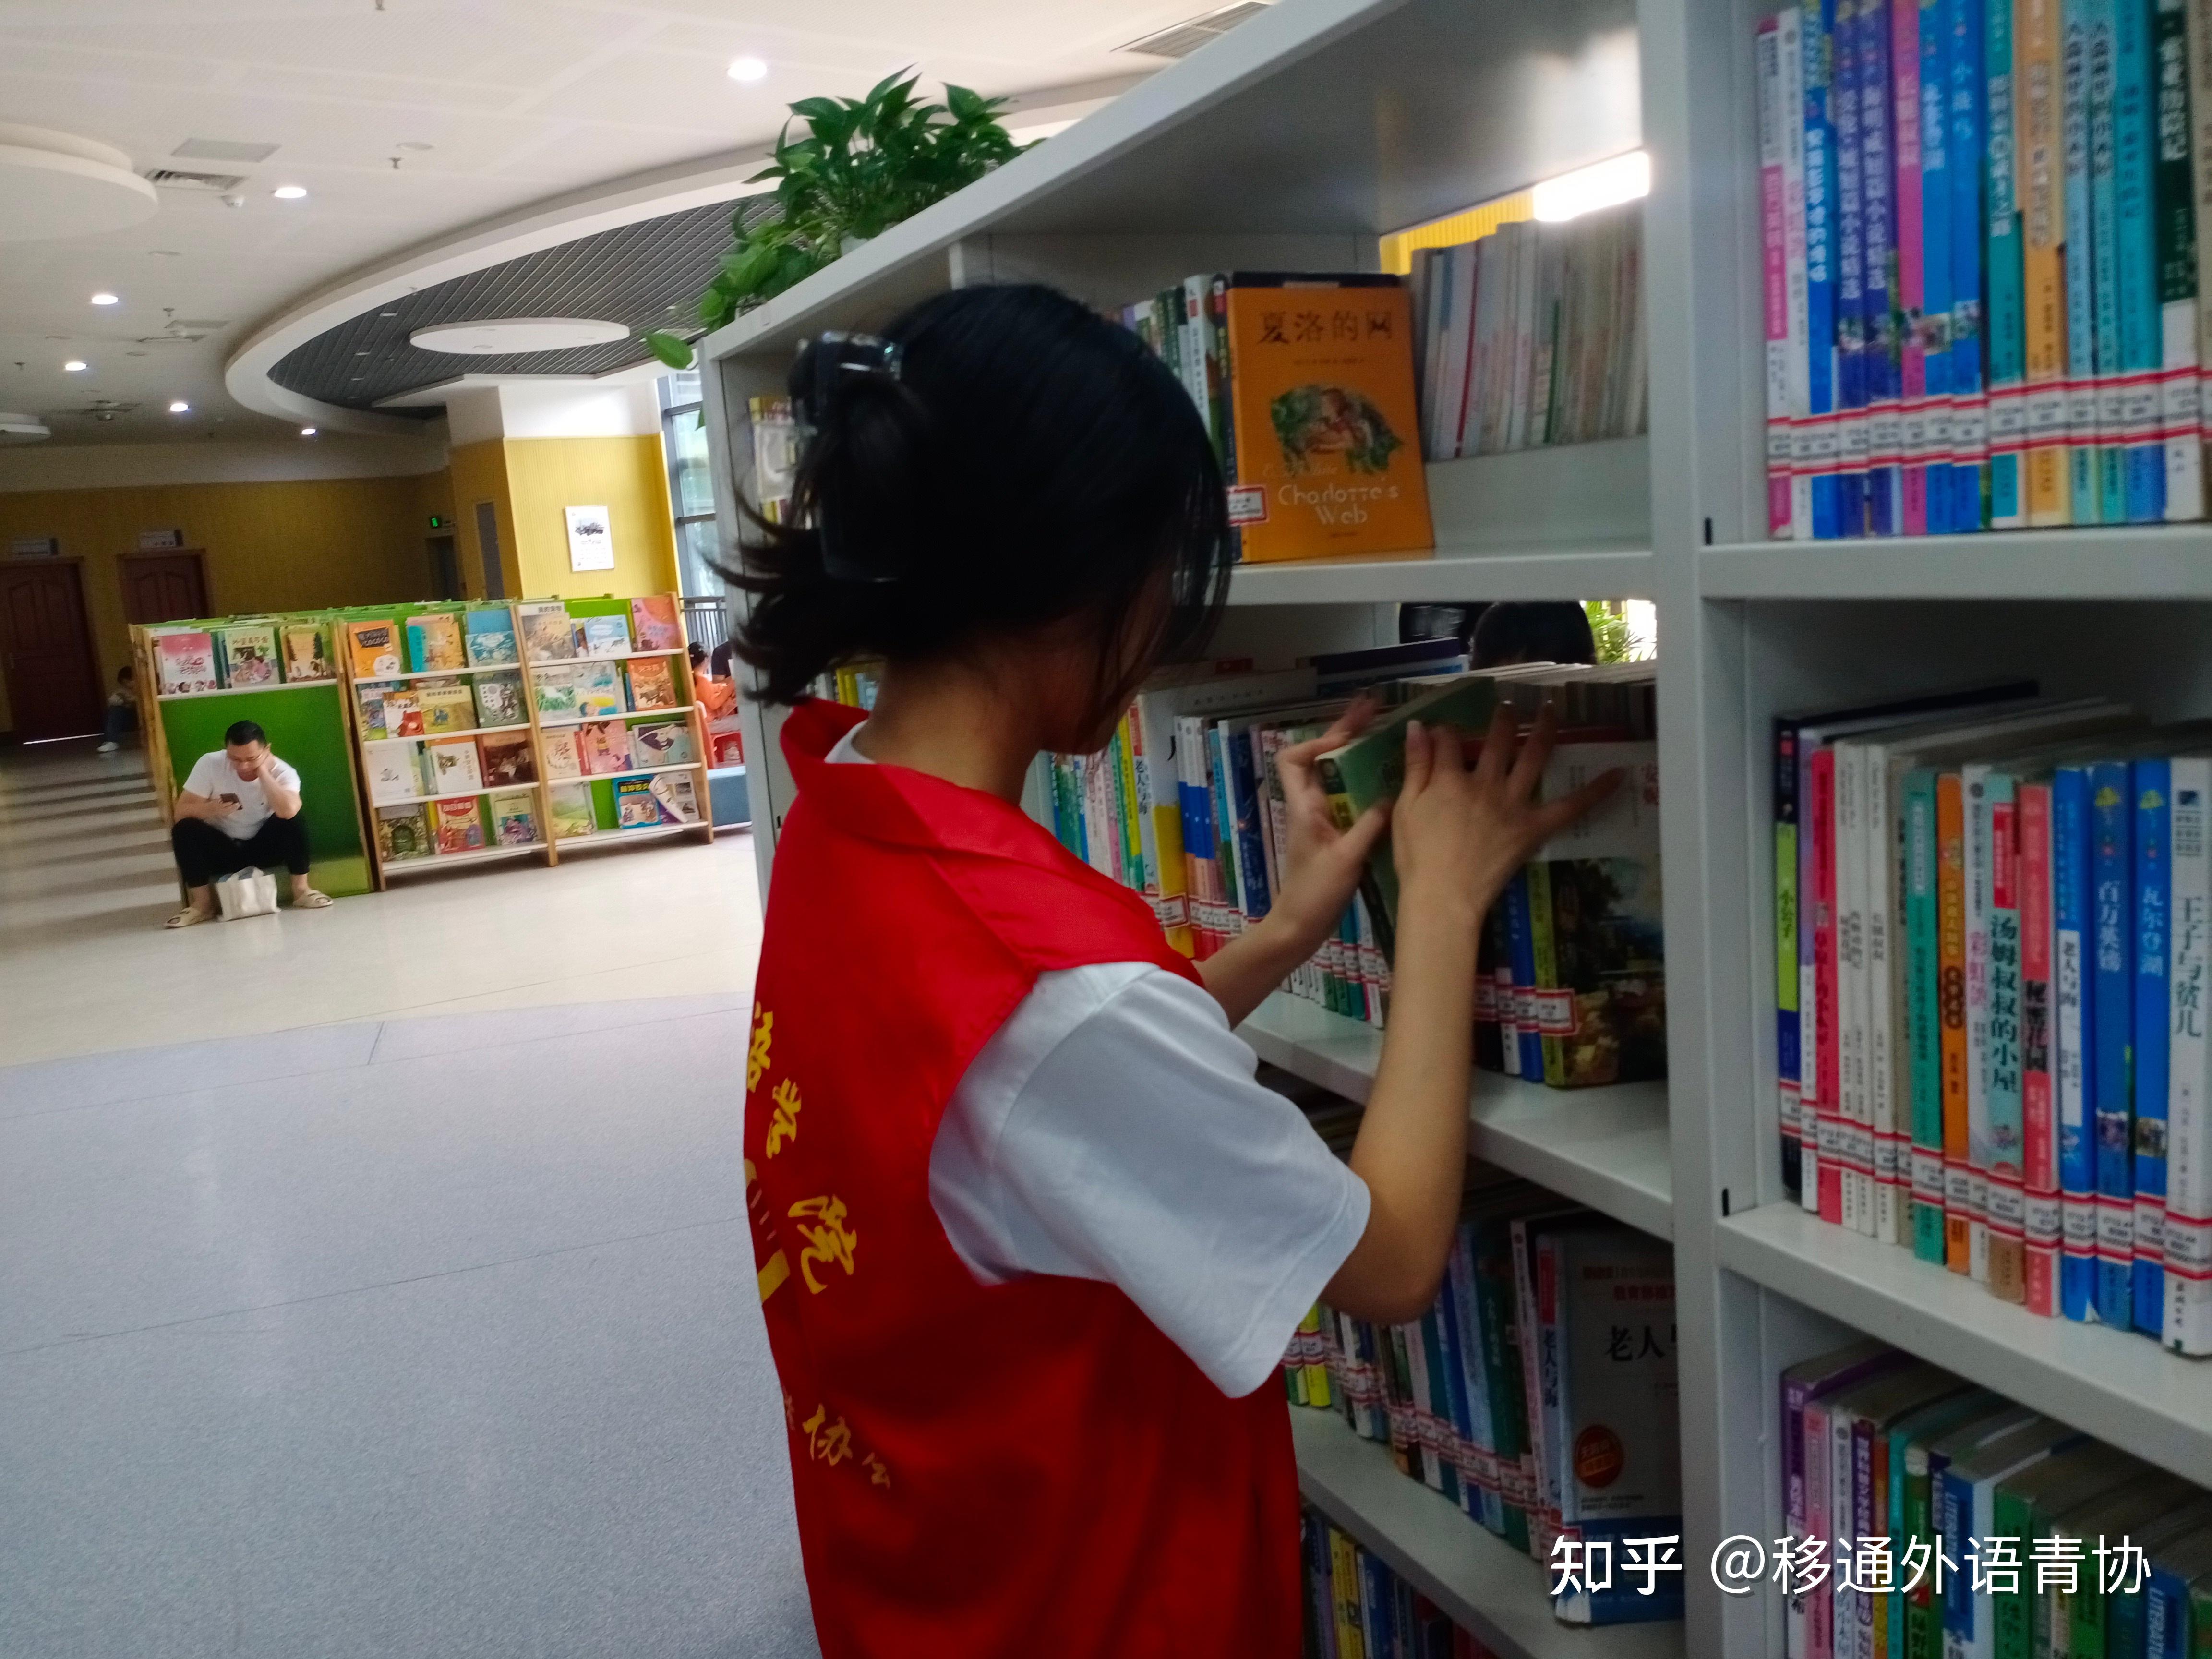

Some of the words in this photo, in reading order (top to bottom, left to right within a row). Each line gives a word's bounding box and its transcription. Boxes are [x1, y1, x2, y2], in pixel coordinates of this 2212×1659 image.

[1257, 310, 1392, 344] 夏洛的网
[1278, 477, 1399, 506] Charlotte's
[1315, 505, 1368, 525] Web
[1135, 759, 1149, 817] 老人与海
[2098, 880, 2122, 973] 百万英镑
[2140, 886, 2164, 976] 瓦尔登湖
[1991, 914, 2018, 1092] 汤姆叔叔的小屋
[2061, 941, 2078, 1008] 老人与海
[2174, 896, 2202, 1038] 王子与贫儿
[2024, 980, 2049, 1073] 秘密花园
[1543, 1328, 1559, 1408] 老人与海
